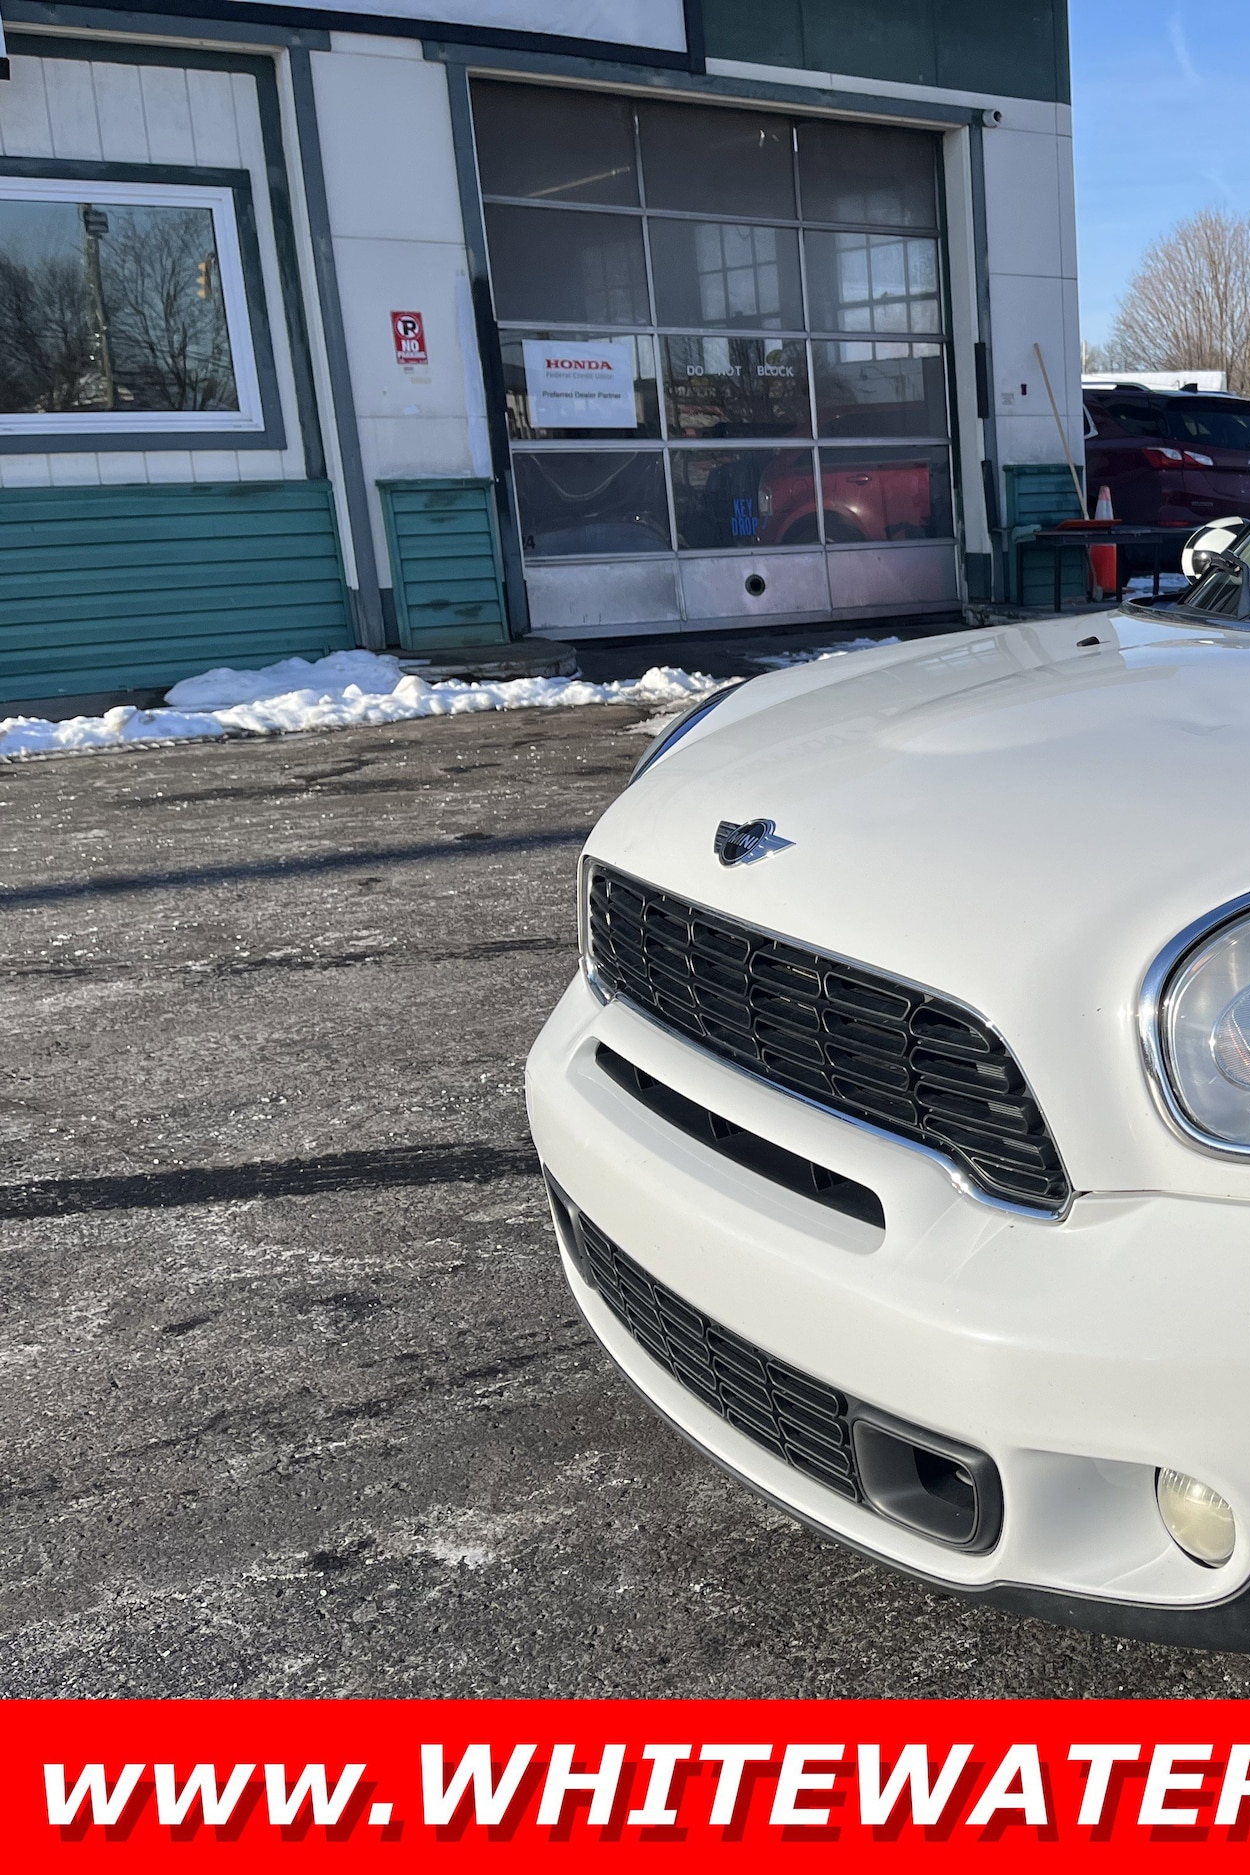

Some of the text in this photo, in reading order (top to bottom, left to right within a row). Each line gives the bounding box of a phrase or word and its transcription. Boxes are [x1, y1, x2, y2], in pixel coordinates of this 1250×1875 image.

[401, 339, 419, 352] NO
[545, 358, 613, 370] HONDA
[546, 371, 571, 379] Federal
[686, 365, 704, 376] DO
[757, 365, 794, 377] BLOCK
[542, 390, 574, 398] Preferred
[597, 391, 622, 399] Partner
[734, 498, 753, 517] KEY
[731, 516, 759, 537] DROP
[728, 832, 759, 850] MINI
